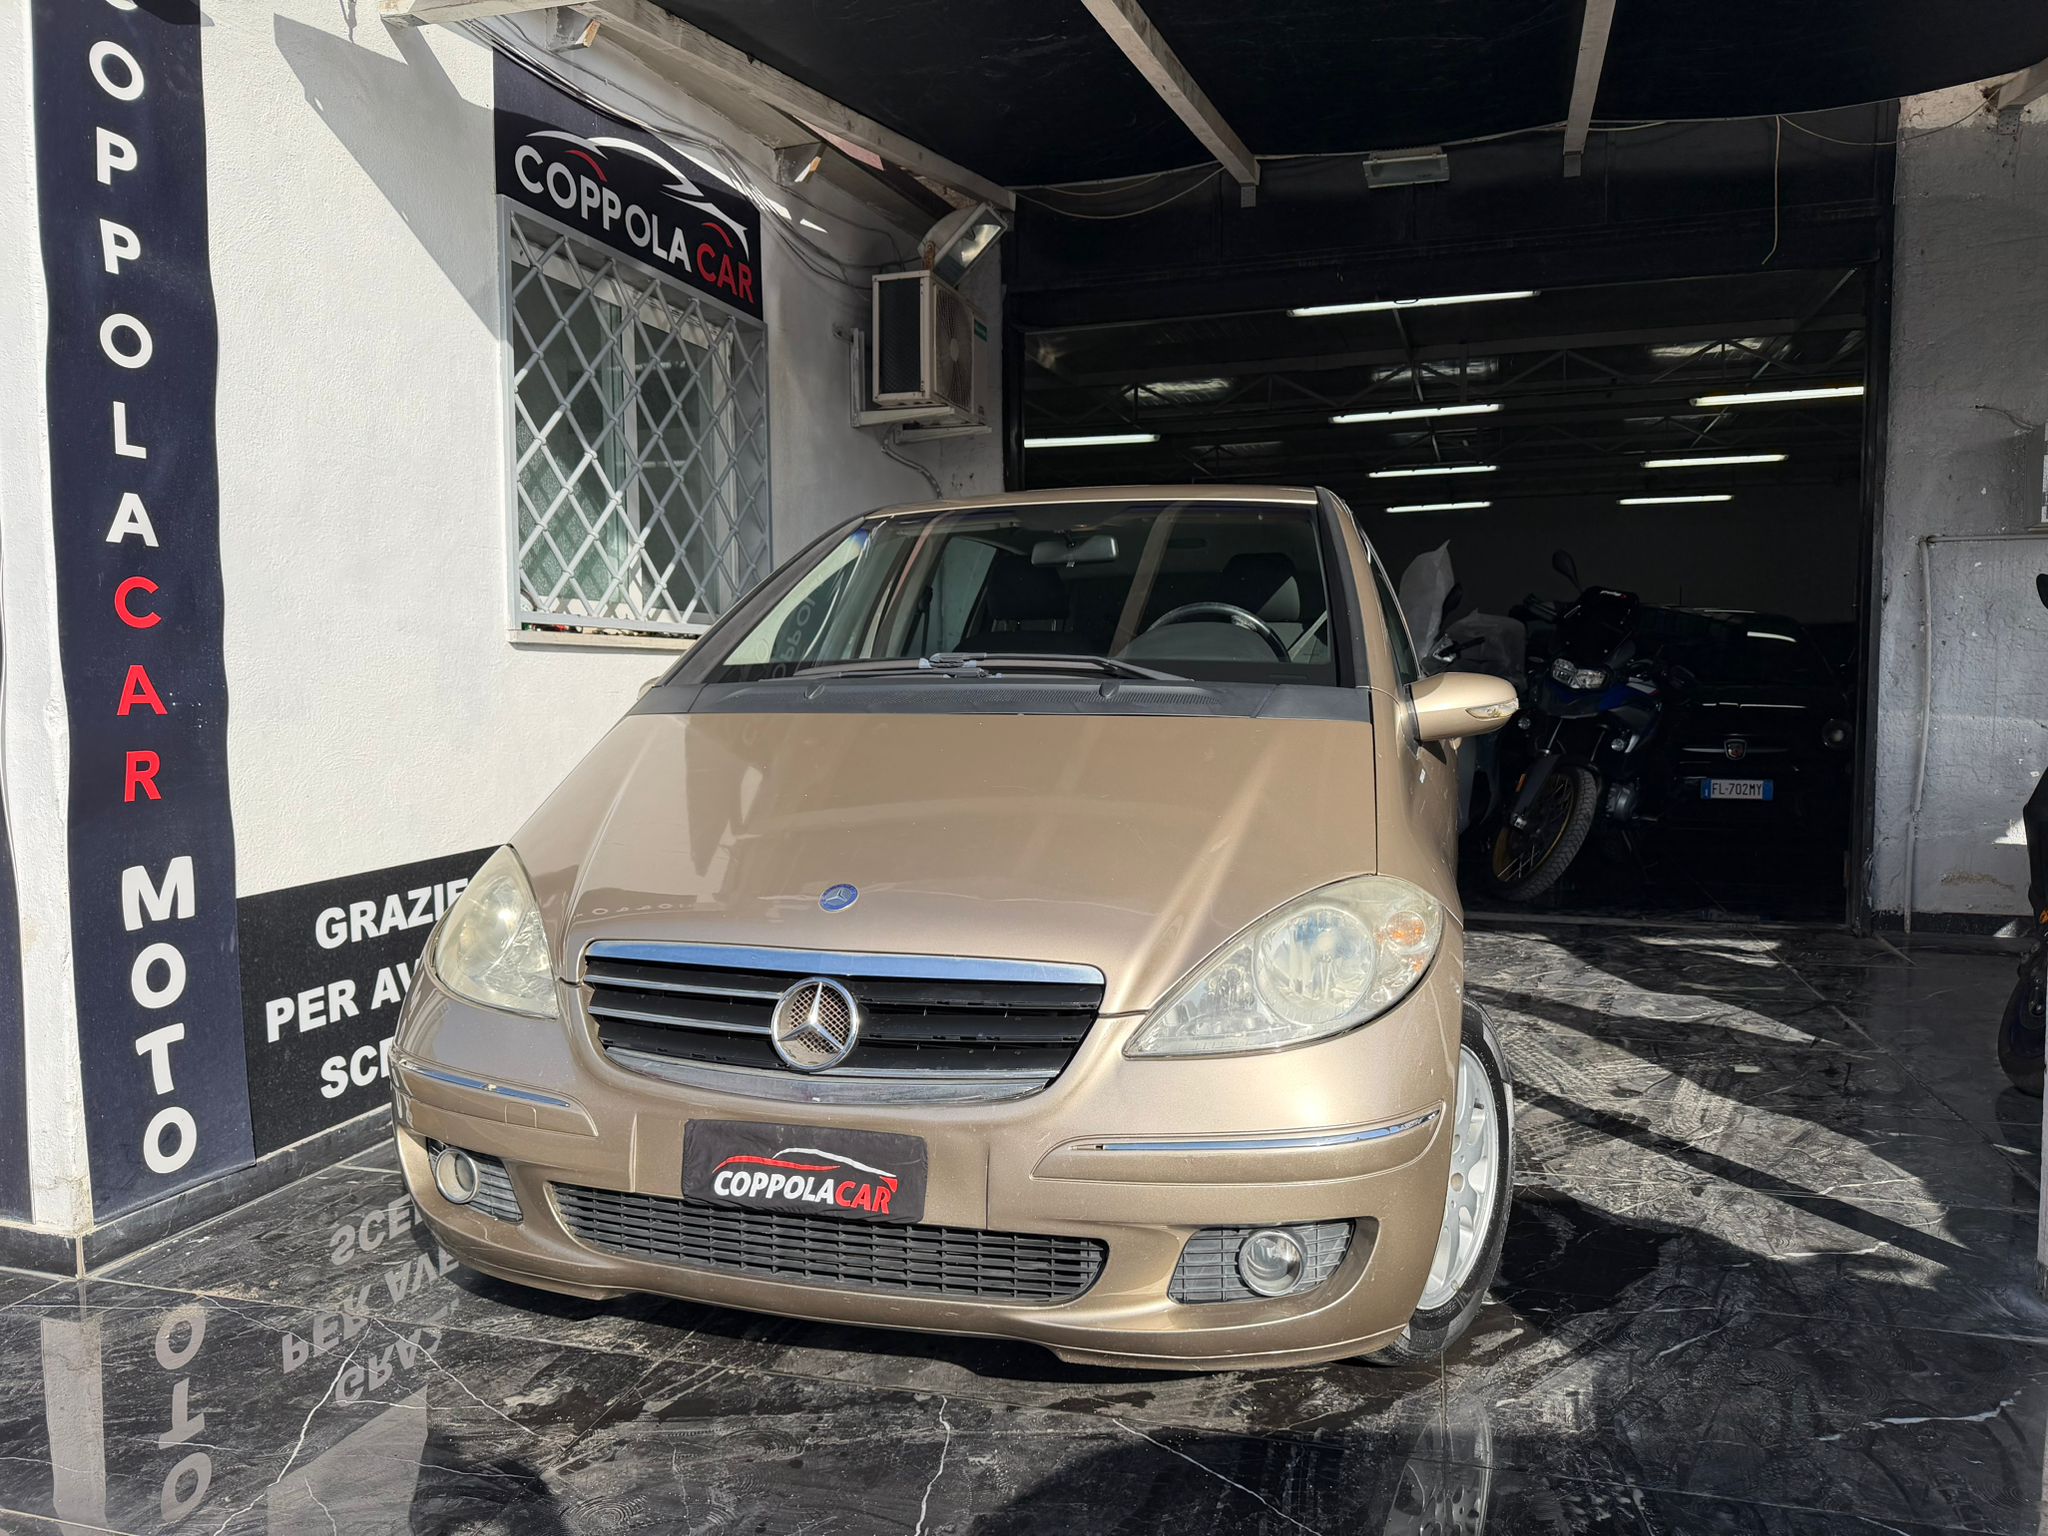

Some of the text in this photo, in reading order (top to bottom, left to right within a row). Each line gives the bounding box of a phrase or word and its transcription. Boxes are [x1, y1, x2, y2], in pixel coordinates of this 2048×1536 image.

[88, 0, 159, 548] OPPOLA
[122, 855, 197, 1174] MOTO
[265, 979, 360, 1043] PER
